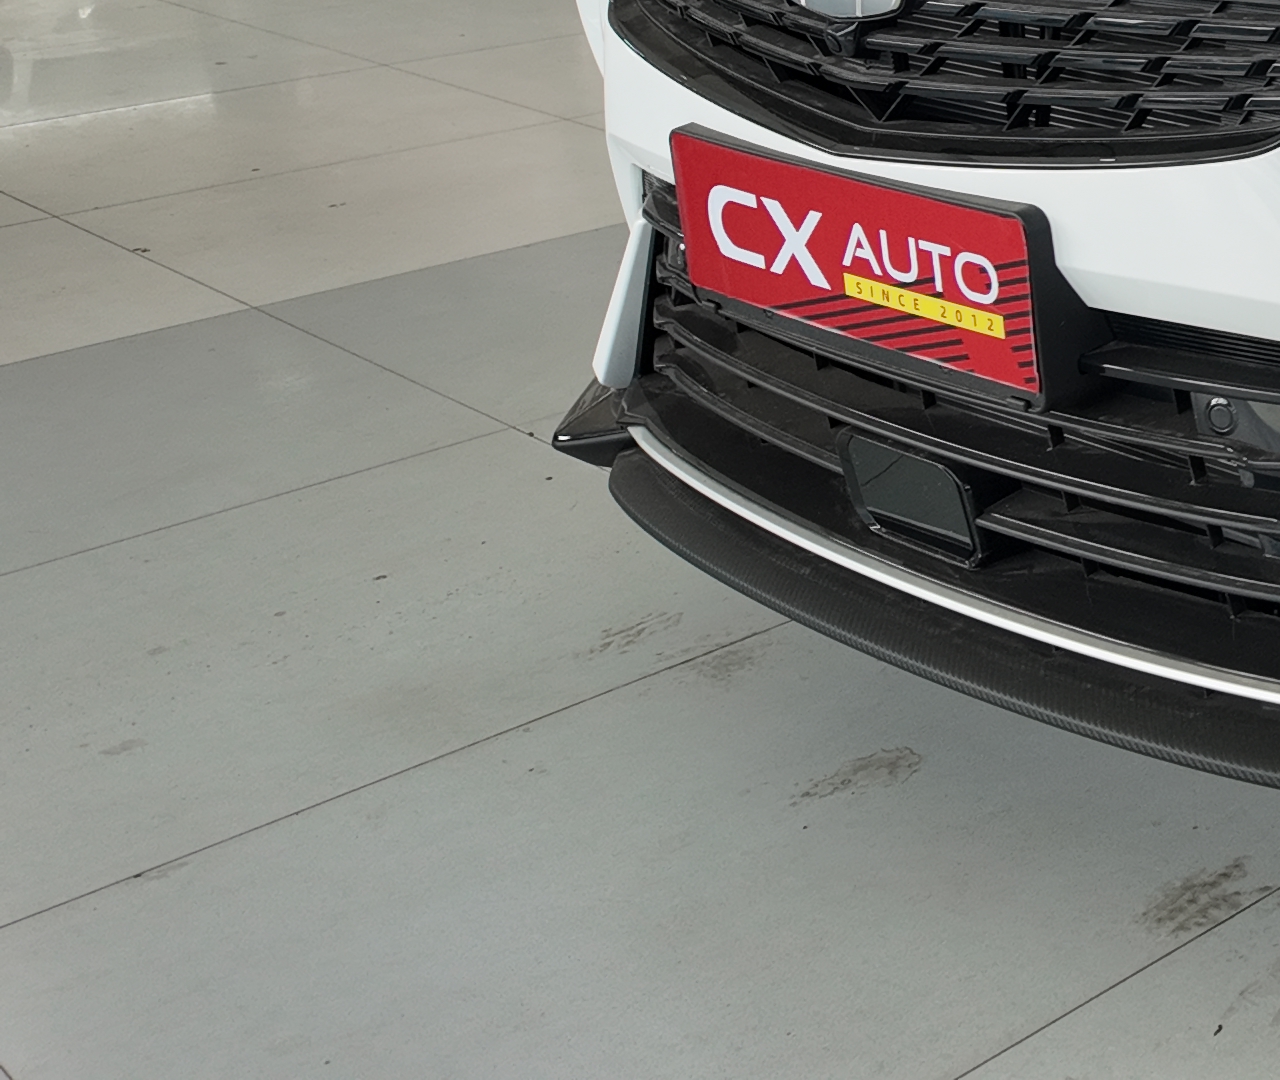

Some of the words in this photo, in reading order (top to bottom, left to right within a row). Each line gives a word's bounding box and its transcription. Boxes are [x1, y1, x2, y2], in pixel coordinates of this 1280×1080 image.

[706, 184, 832, 291] CX
[842, 222, 1000, 305] AUTO
[855, 280, 922, 312] SINCE
[939, 305, 995, 333] 2012
